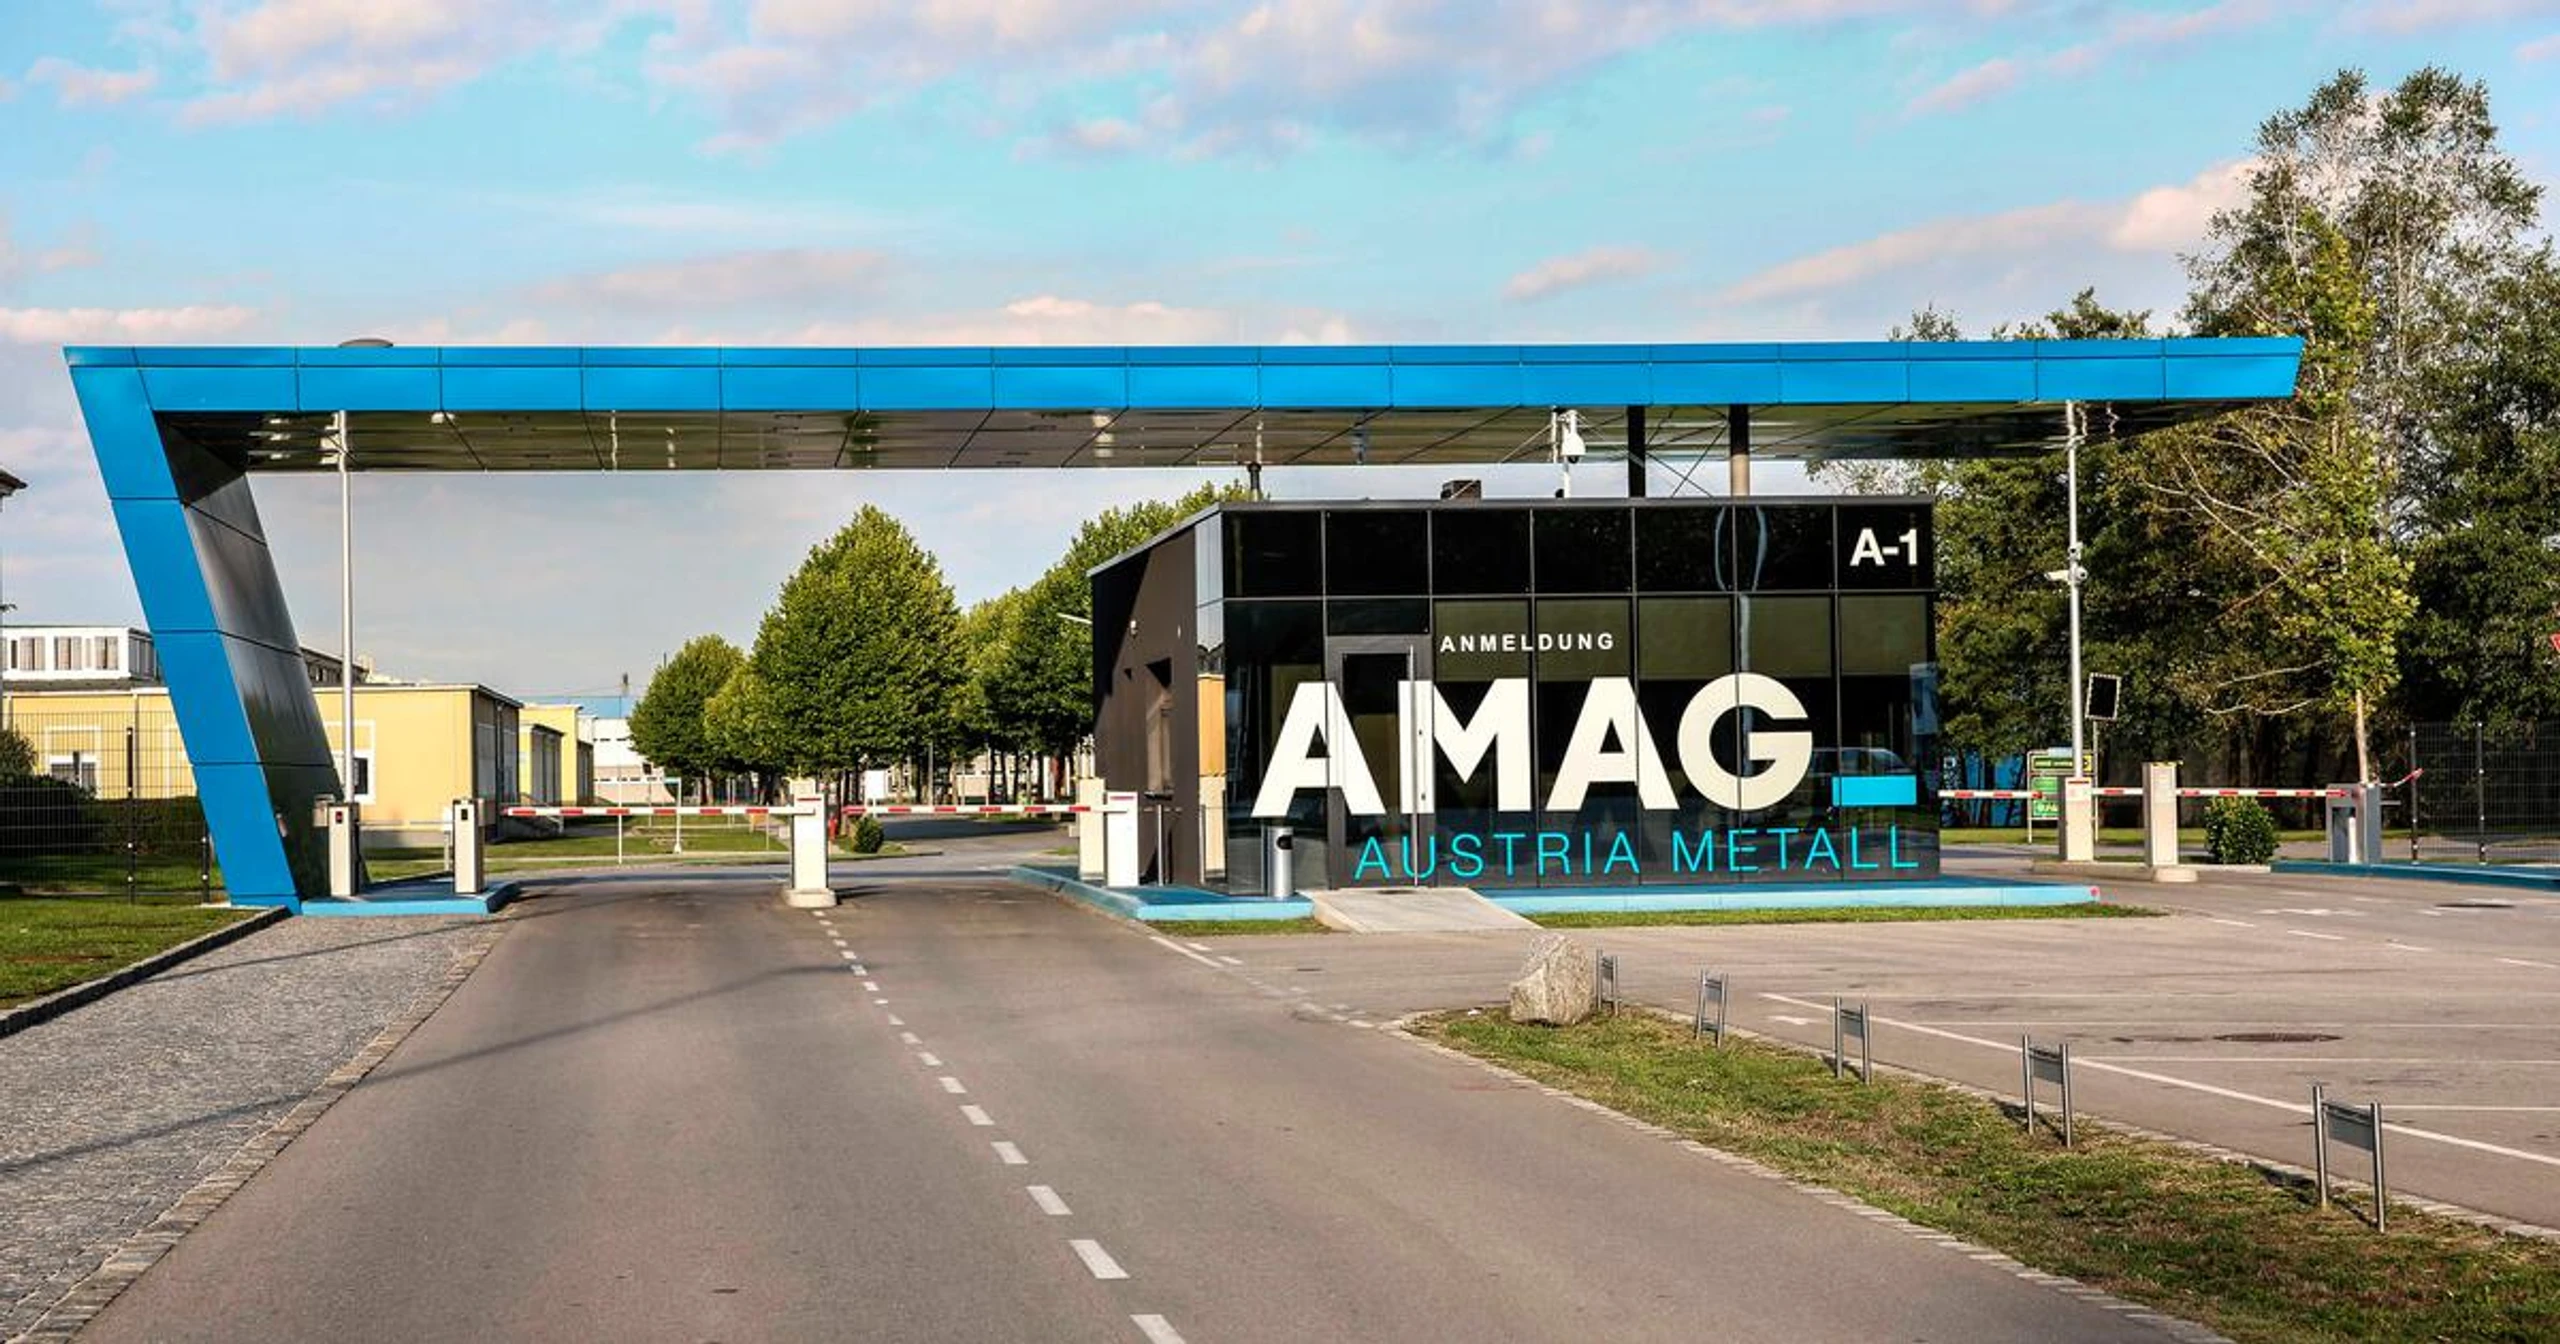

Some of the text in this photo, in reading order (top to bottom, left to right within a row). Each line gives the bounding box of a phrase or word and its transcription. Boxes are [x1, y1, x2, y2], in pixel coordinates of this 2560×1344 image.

[1849, 527, 1917, 566] A-1
[1440, 632, 1614, 652] ANMELDUNG
[1250, 672, 1813, 817] AMAG
[1354, 824, 1919, 880] AUSTRIA METALL
